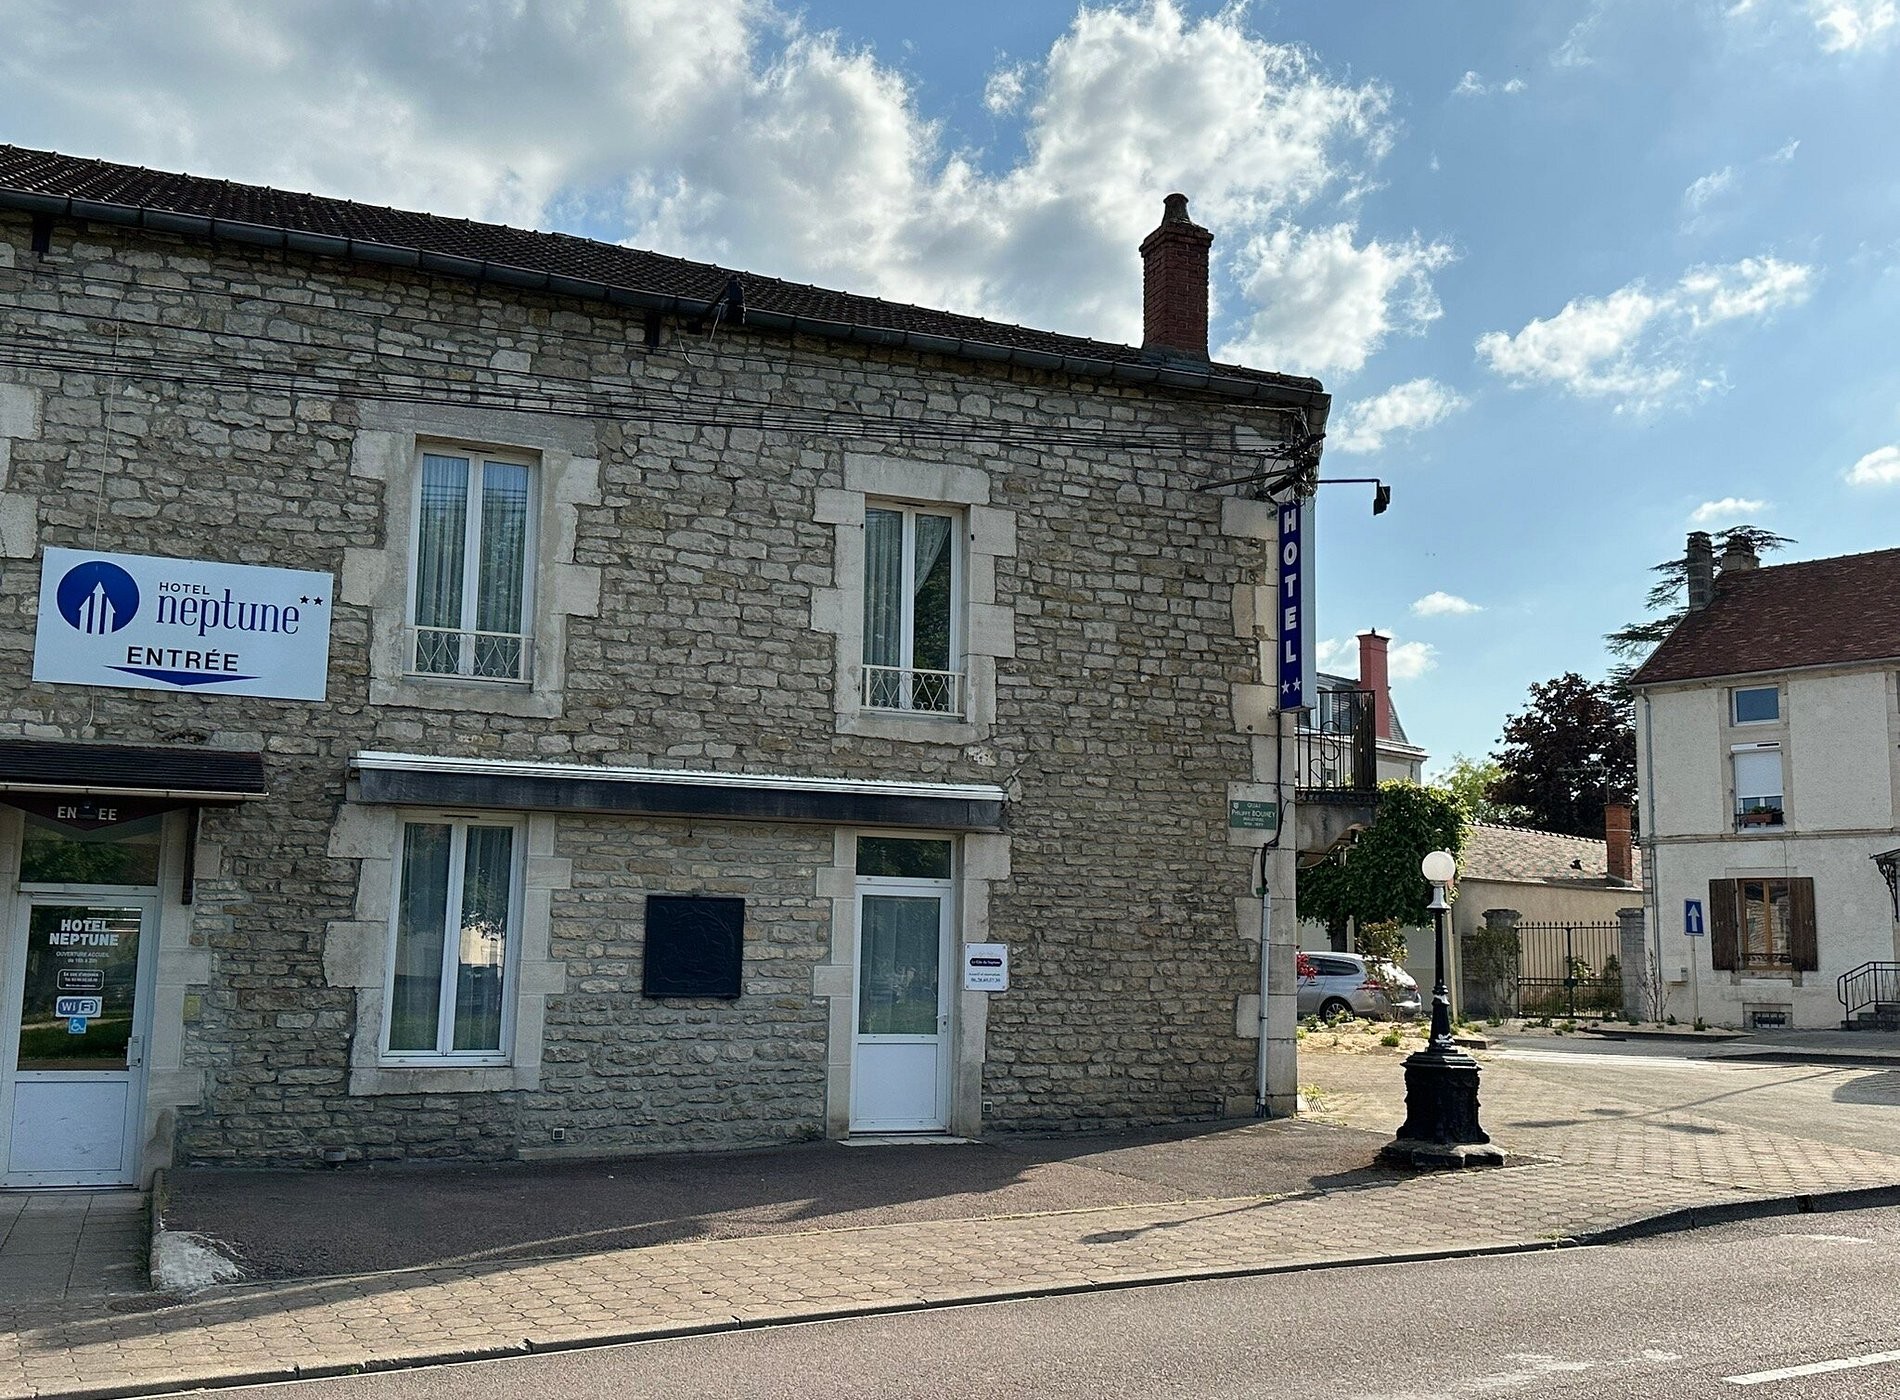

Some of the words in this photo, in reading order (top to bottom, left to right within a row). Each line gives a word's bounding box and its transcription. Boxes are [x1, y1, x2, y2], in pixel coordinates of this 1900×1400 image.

[159, 581, 210, 595] HOTEL
[1283, 508, 1298, 664] HOTEL
[156, 588, 300, 637] neptune
[126, 646, 239, 672] ENTRÉE
[57, 806, 118, 821] ENEE
[61, 919, 109, 932] HOTEL
[49, 932, 119, 946] NEPTUNE
